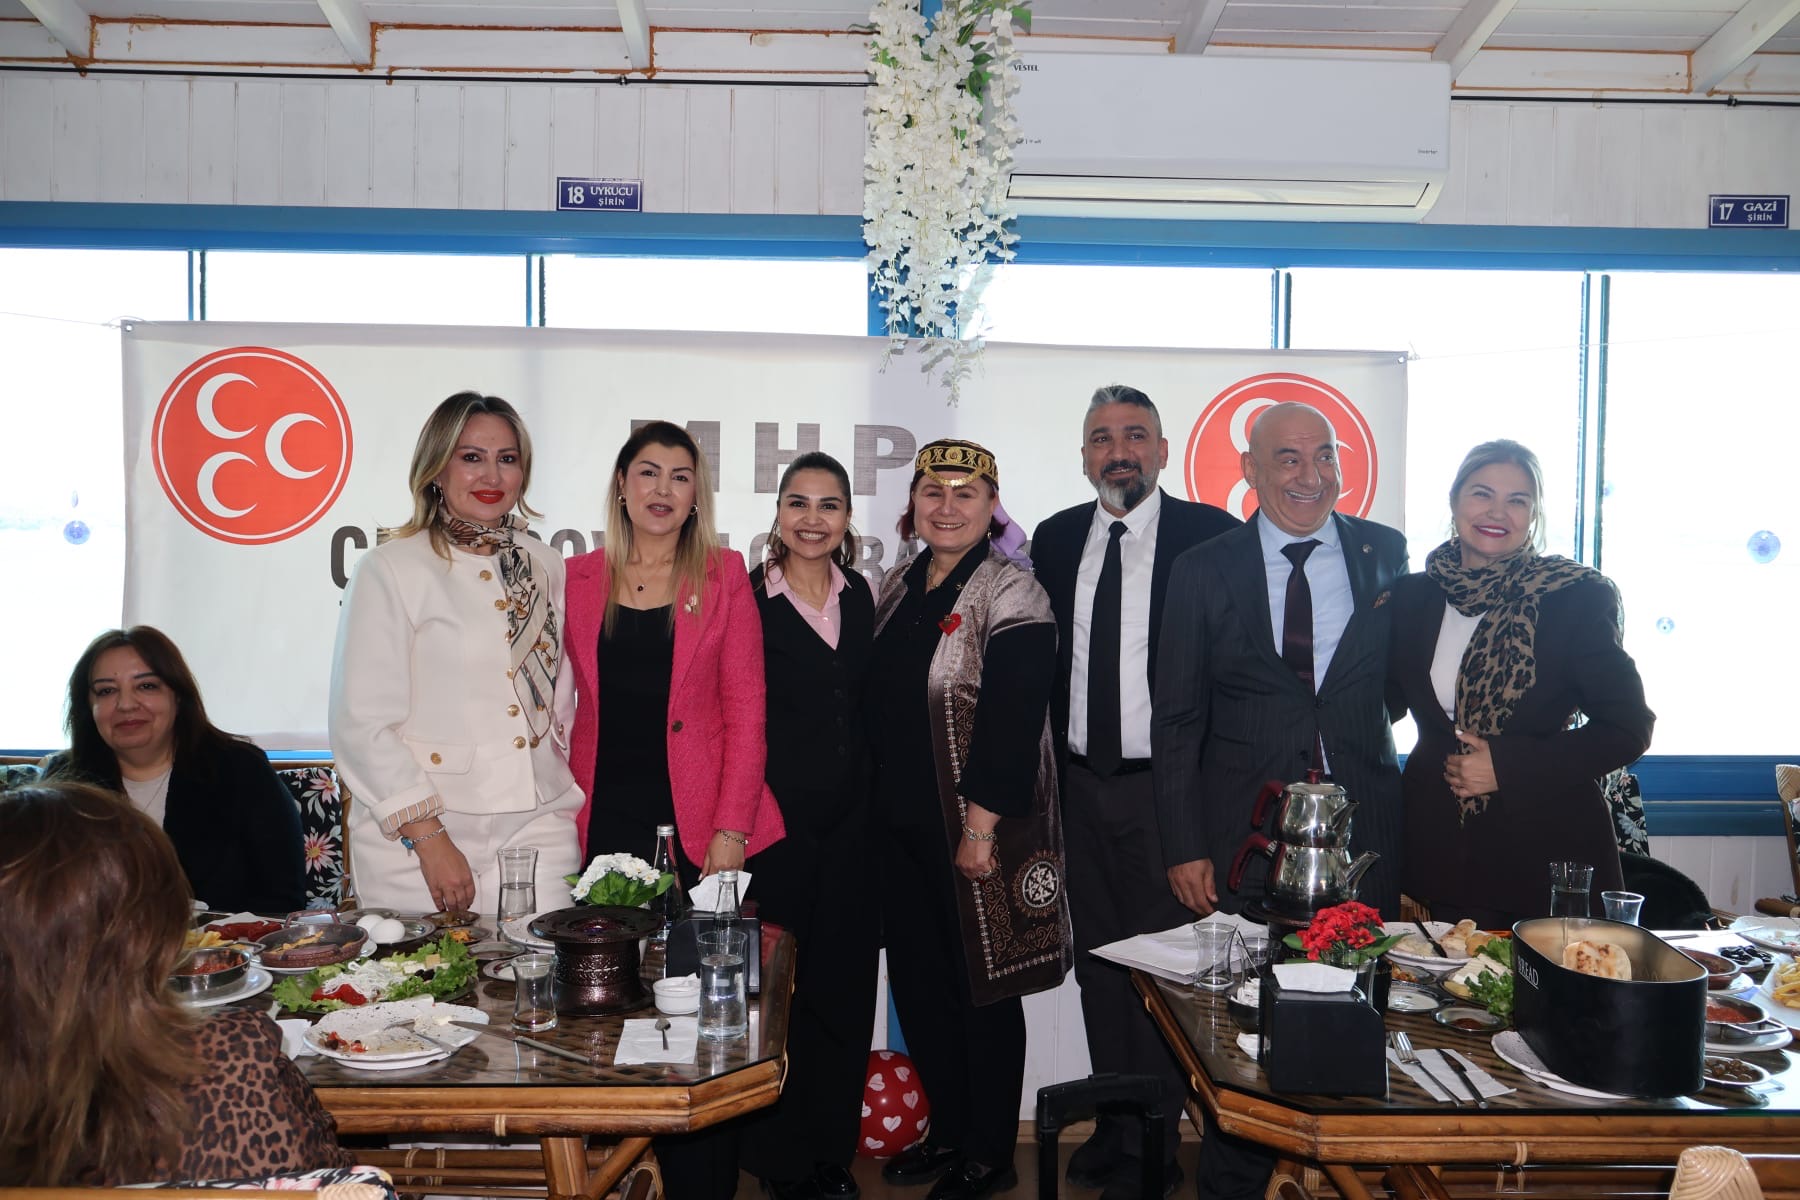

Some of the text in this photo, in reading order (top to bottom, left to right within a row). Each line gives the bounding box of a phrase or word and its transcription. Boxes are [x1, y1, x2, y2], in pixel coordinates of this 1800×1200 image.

[1013, 64, 1039, 72] VESTEL
[567, 186, 633, 205] 18 UYKUCU
[598, 198, 625, 207] ŞİRİN
[1719, 201, 1777, 221] 17 GAZİ
[1747, 213, 1773, 222] ŞİRİN
[1517, 954, 1539, 987] BREAD
